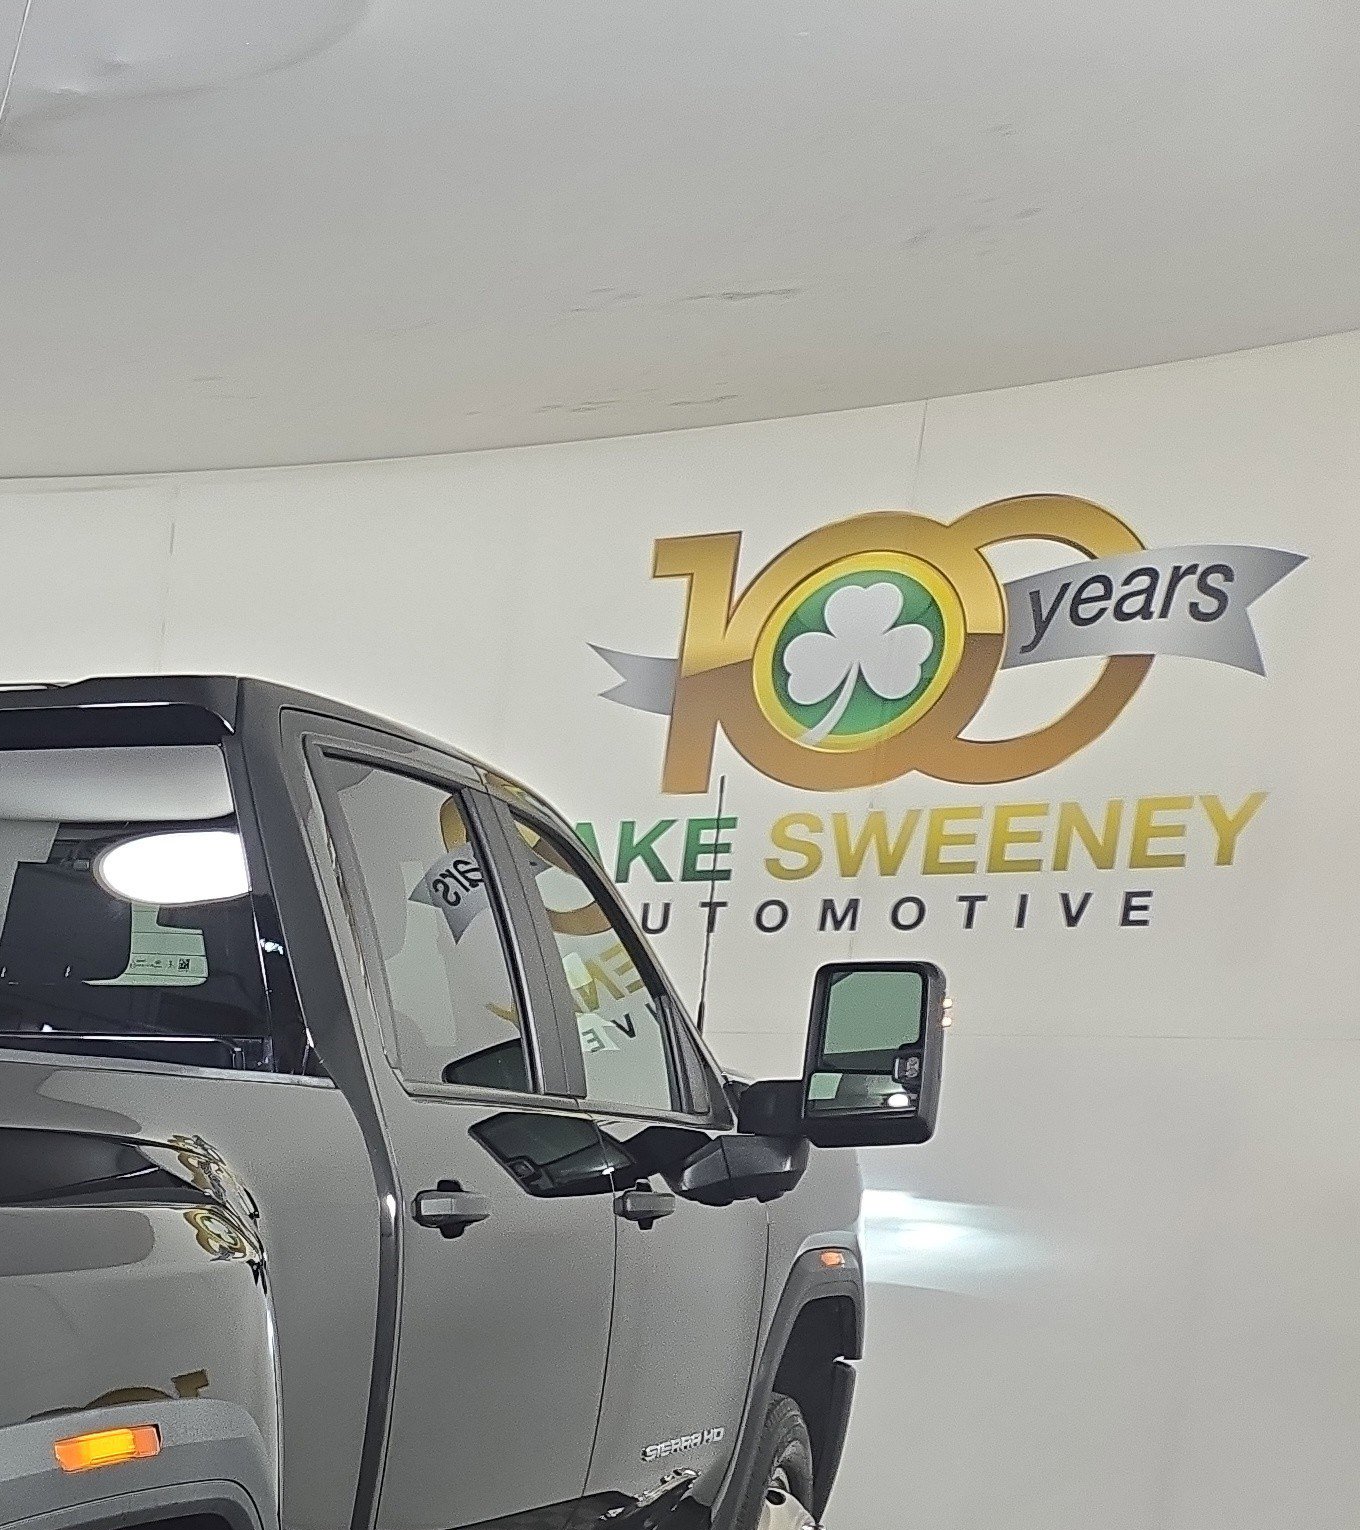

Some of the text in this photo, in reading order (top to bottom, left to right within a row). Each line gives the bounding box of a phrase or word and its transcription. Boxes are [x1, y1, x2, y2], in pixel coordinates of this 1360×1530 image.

[1018, 562, 1235, 653] years
[573, 792, 1268, 884] KE SWEENEY
[641, 890, 1153, 934] UTOMOTIVE
[641, 1426, 725, 1462] SIERRA HD
